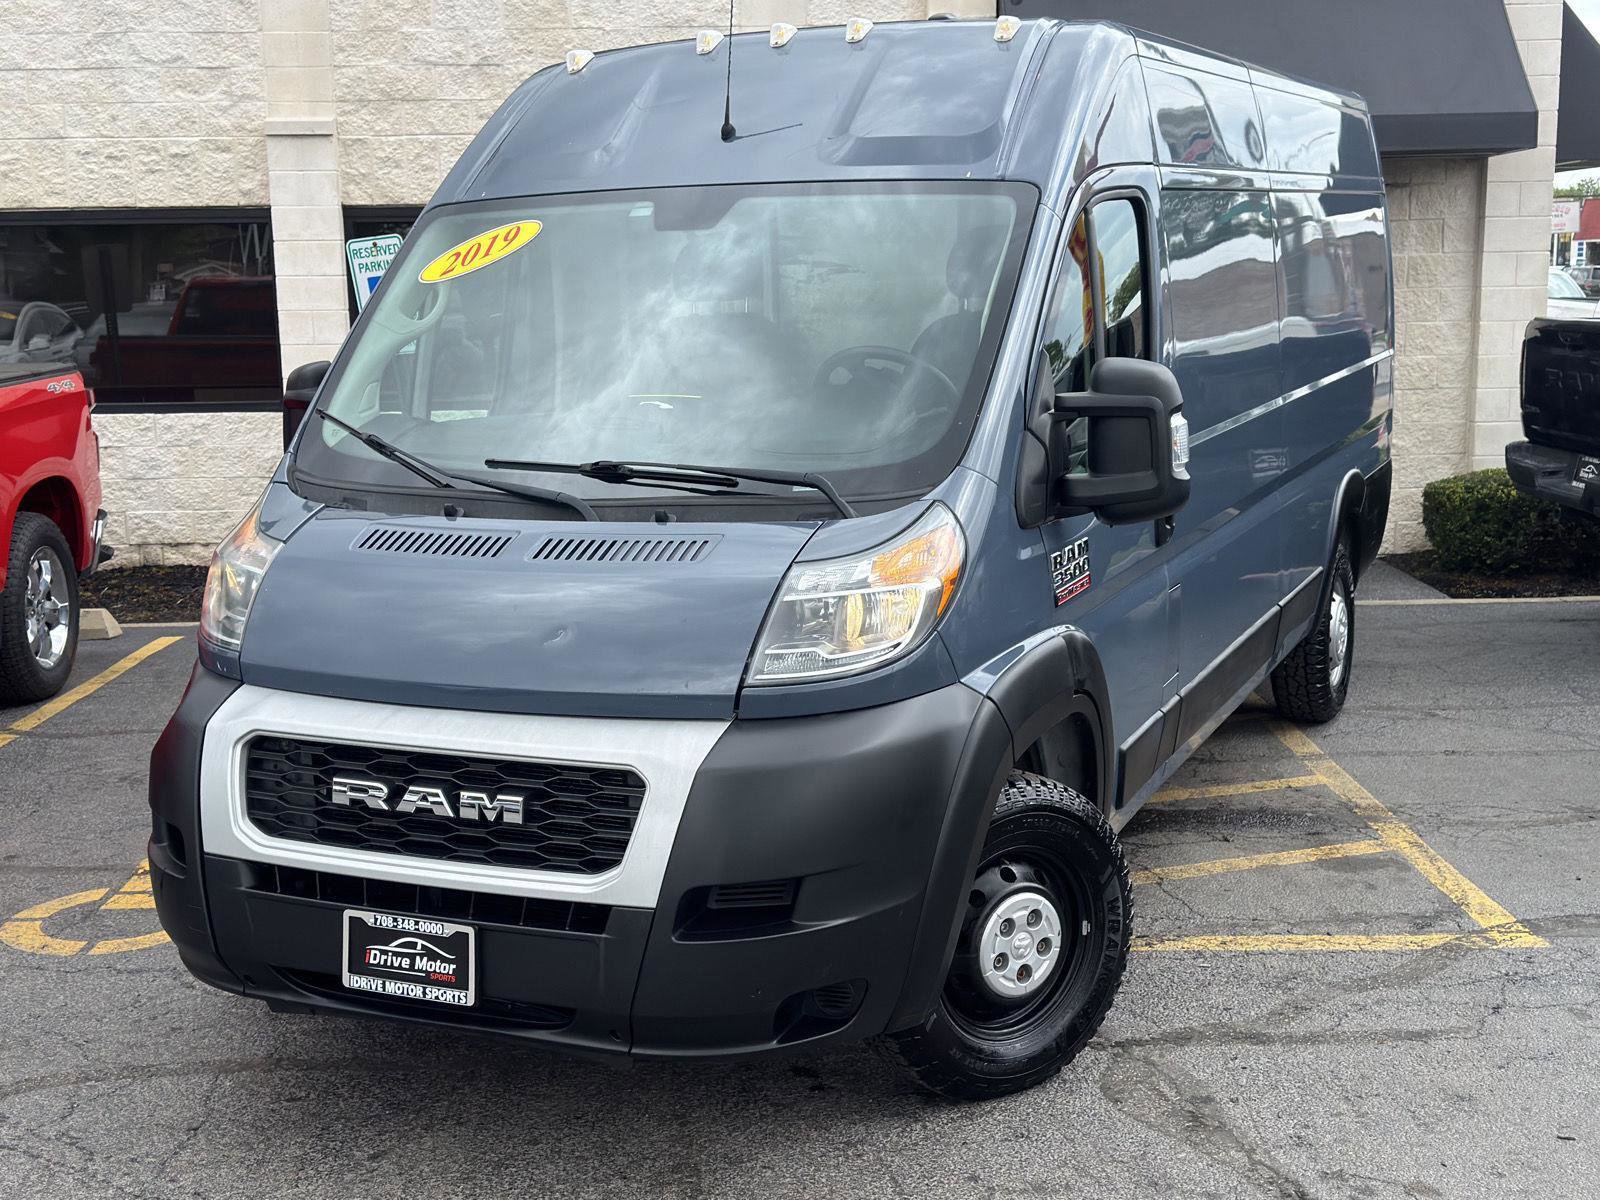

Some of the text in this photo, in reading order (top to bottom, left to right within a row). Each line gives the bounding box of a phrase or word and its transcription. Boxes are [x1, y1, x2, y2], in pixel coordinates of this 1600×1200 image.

[352, 243, 401, 259] RESERVED
[439, 226, 521, 277] 2019
[358, 258, 394, 273] PARKI
[1050, 537, 1089, 571] RAM
[1053, 555, 1090, 588] 3500
[332, 777, 524, 824] RAM
[375, 915, 443, 934] 708-348-0000
[365, 949, 456, 975] iDrive Motor
[430, 972, 456, 983] SPORTS
[385, 980, 423, 998] MOTOR
[425, 987, 467, 1004] SPORTS
